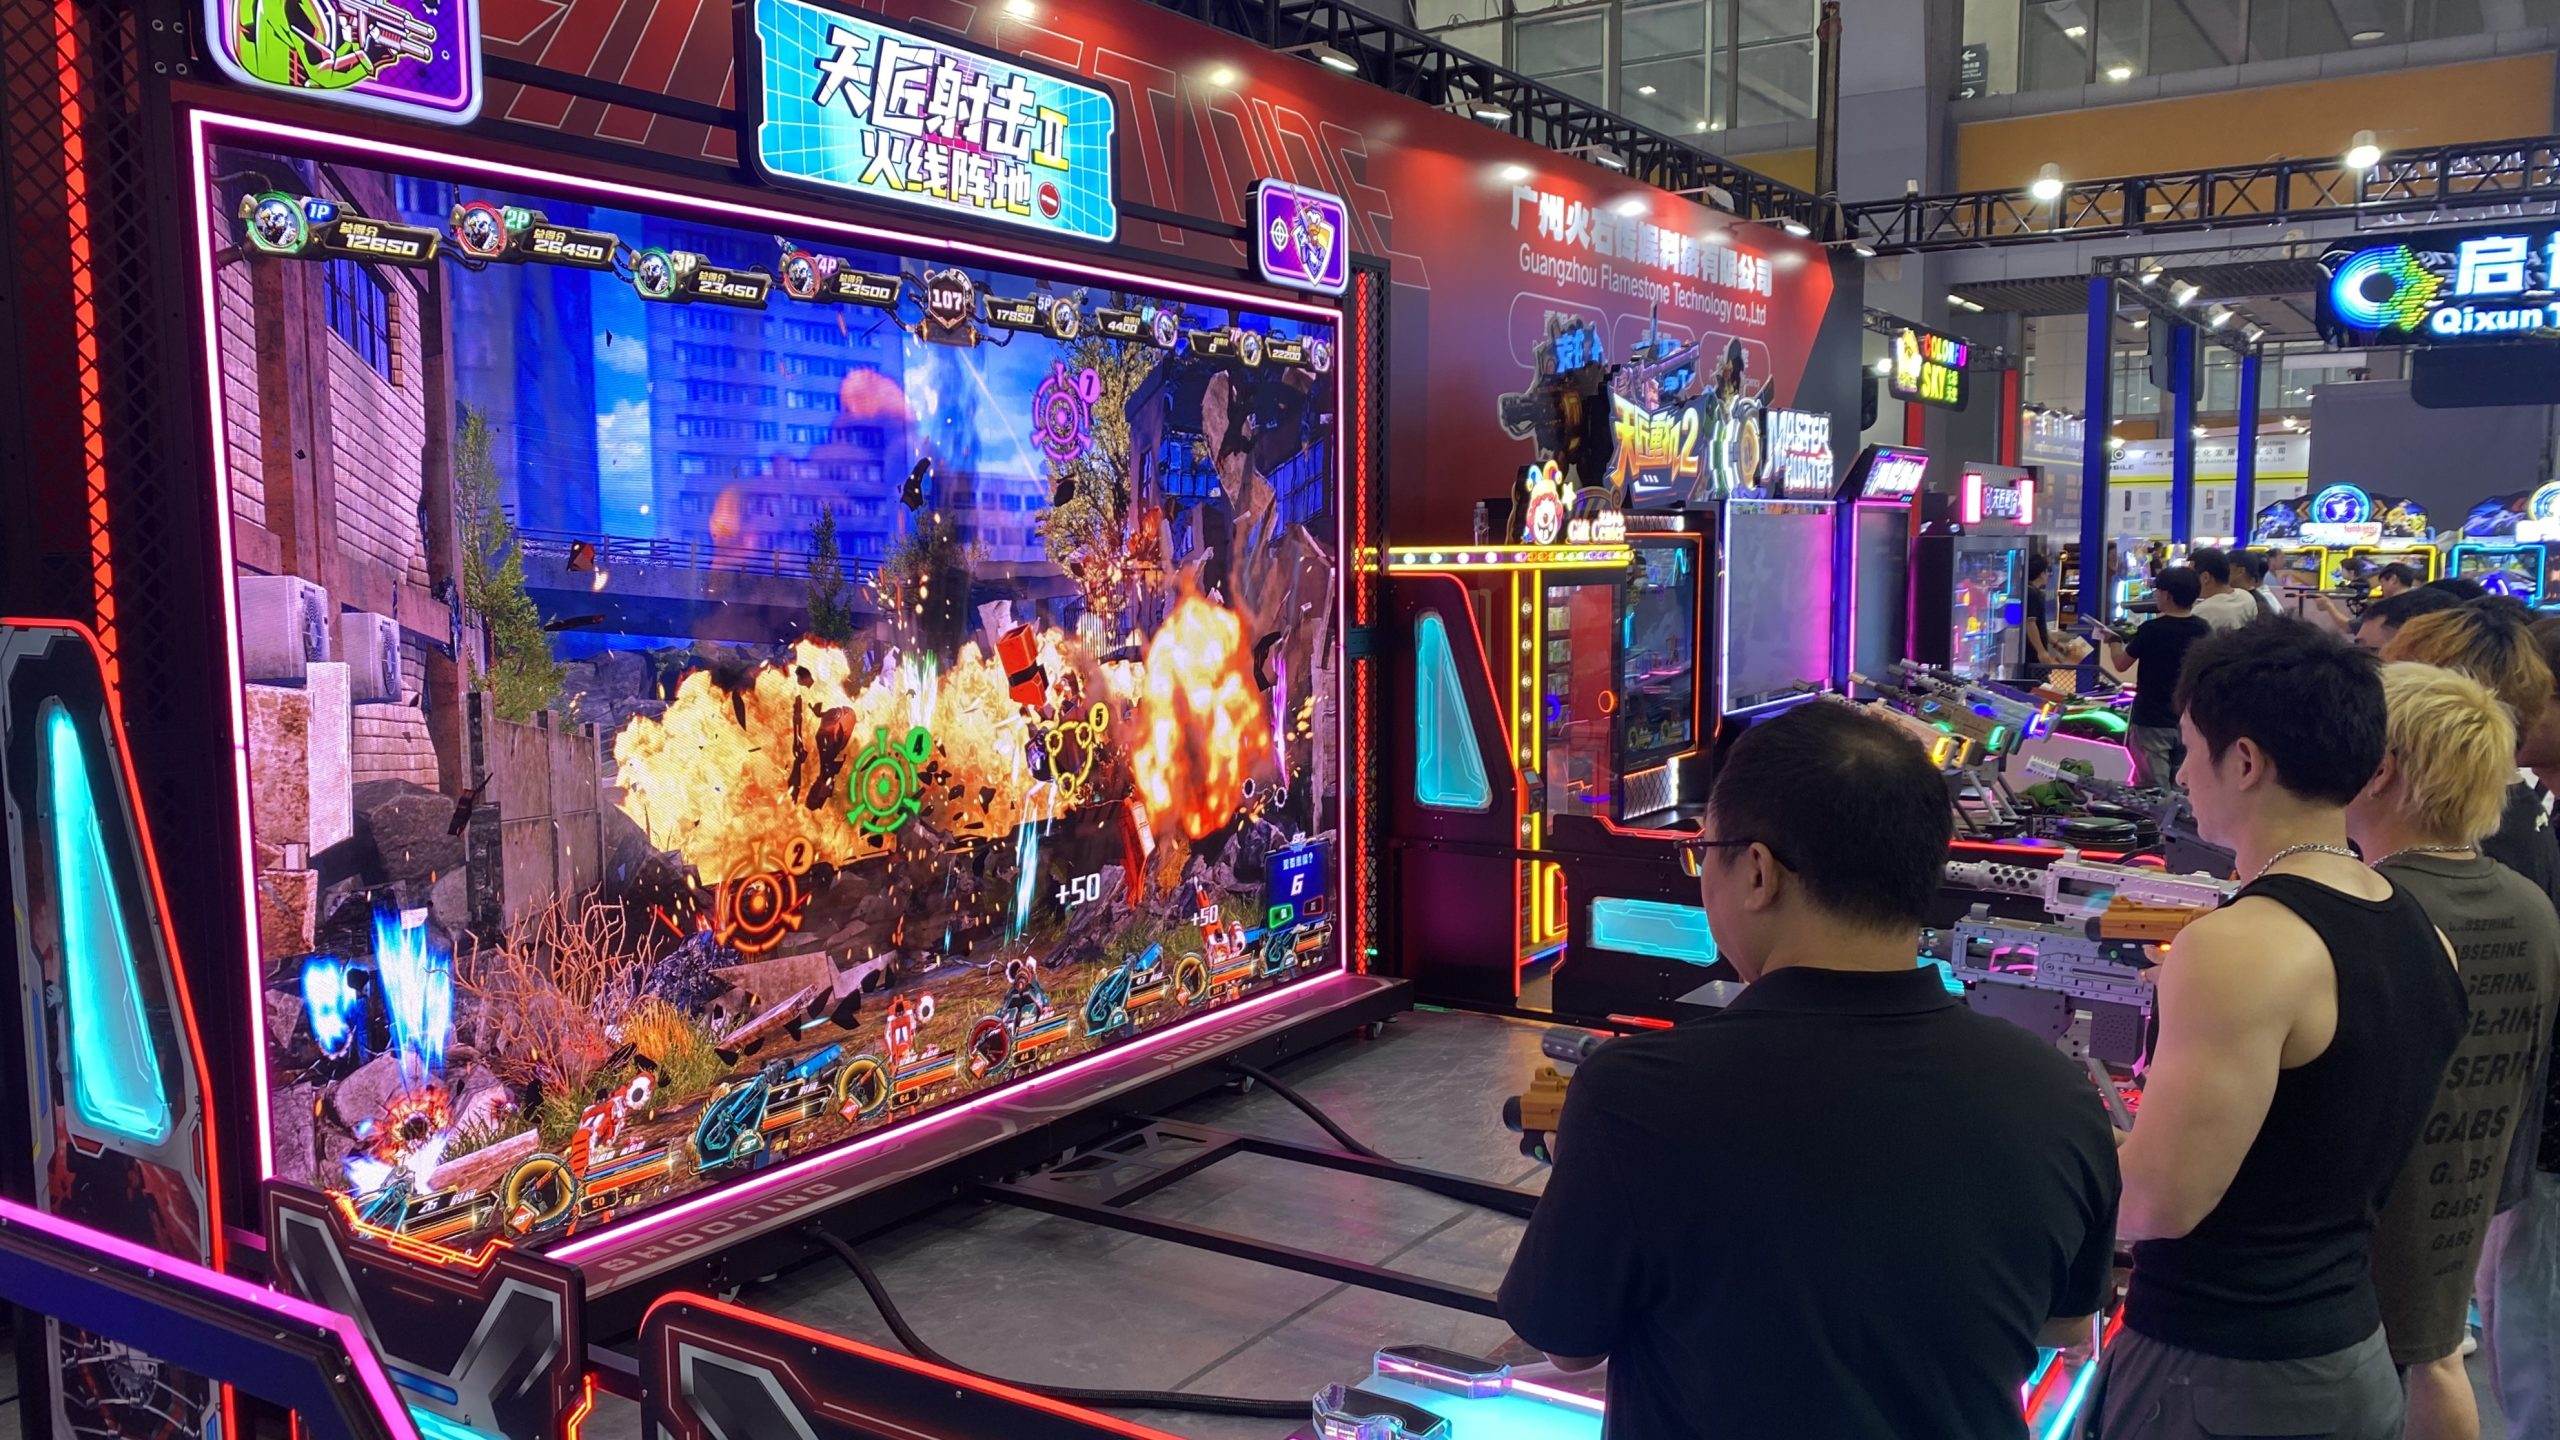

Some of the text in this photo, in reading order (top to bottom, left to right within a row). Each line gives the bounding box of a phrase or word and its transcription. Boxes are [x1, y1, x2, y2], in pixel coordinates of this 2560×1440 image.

[858, 130, 1032, 216] 火线阵地
[310, 203, 329, 220] 1P
[507, 210, 529, 229] 2P
[339, 221, 379, 236] 总得分
[533, 228, 566, 242] 总得分
[345, 234, 419, 256] 12650
[533, 239, 604, 259] 26450
[674, 254, 696, 272] 3P
[818, 257, 837, 273] 4P
[2455, 235, 2560, 296] 启
[699, 280, 758, 298] 23450
[1519, 242, 1598, 287] Guangzhou
[1600, 264, 1670, 304] Flamestone
[1673, 282, 1733, 317] Technology
[840, 282, 891, 299] 23500
[932, 288, 962, 311] 107
[1038, 297, 1051, 311] 5P
[996, 309, 1034, 324] 17850
[1107, 321, 1138, 333] 4400
[2431, 304, 2544, 335] Qixun
[1272, 349, 1302, 361] 22200
[1086, 375, 1094, 396] 7
[1921, 362, 1947, 399] SKY
[1761, 411, 1829, 482] MASTER
[1785, 452, 1833, 489] HUNTER
[1095, 709, 1104, 724] 5
[912, 733, 924, 755] 4
[792, 845, 805, 868] 2
[1056, 873, 1100, 906] +50
[1290, 874, 1304, 896] 6
[1191, 905, 1218, 926] +50
[1152, 1013, 1286, 1061] SHOOTING
[2423, 1105, 2510, 1145] GABS
[2429, 1156, 2492, 1185] GBS
[418, 1199, 438, 1214] 26
[591, 1197, 605, 1208] 50
[2430, 1195, 2483, 1220] GABS
[600, 1183, 837, 1271] SHOOTING
